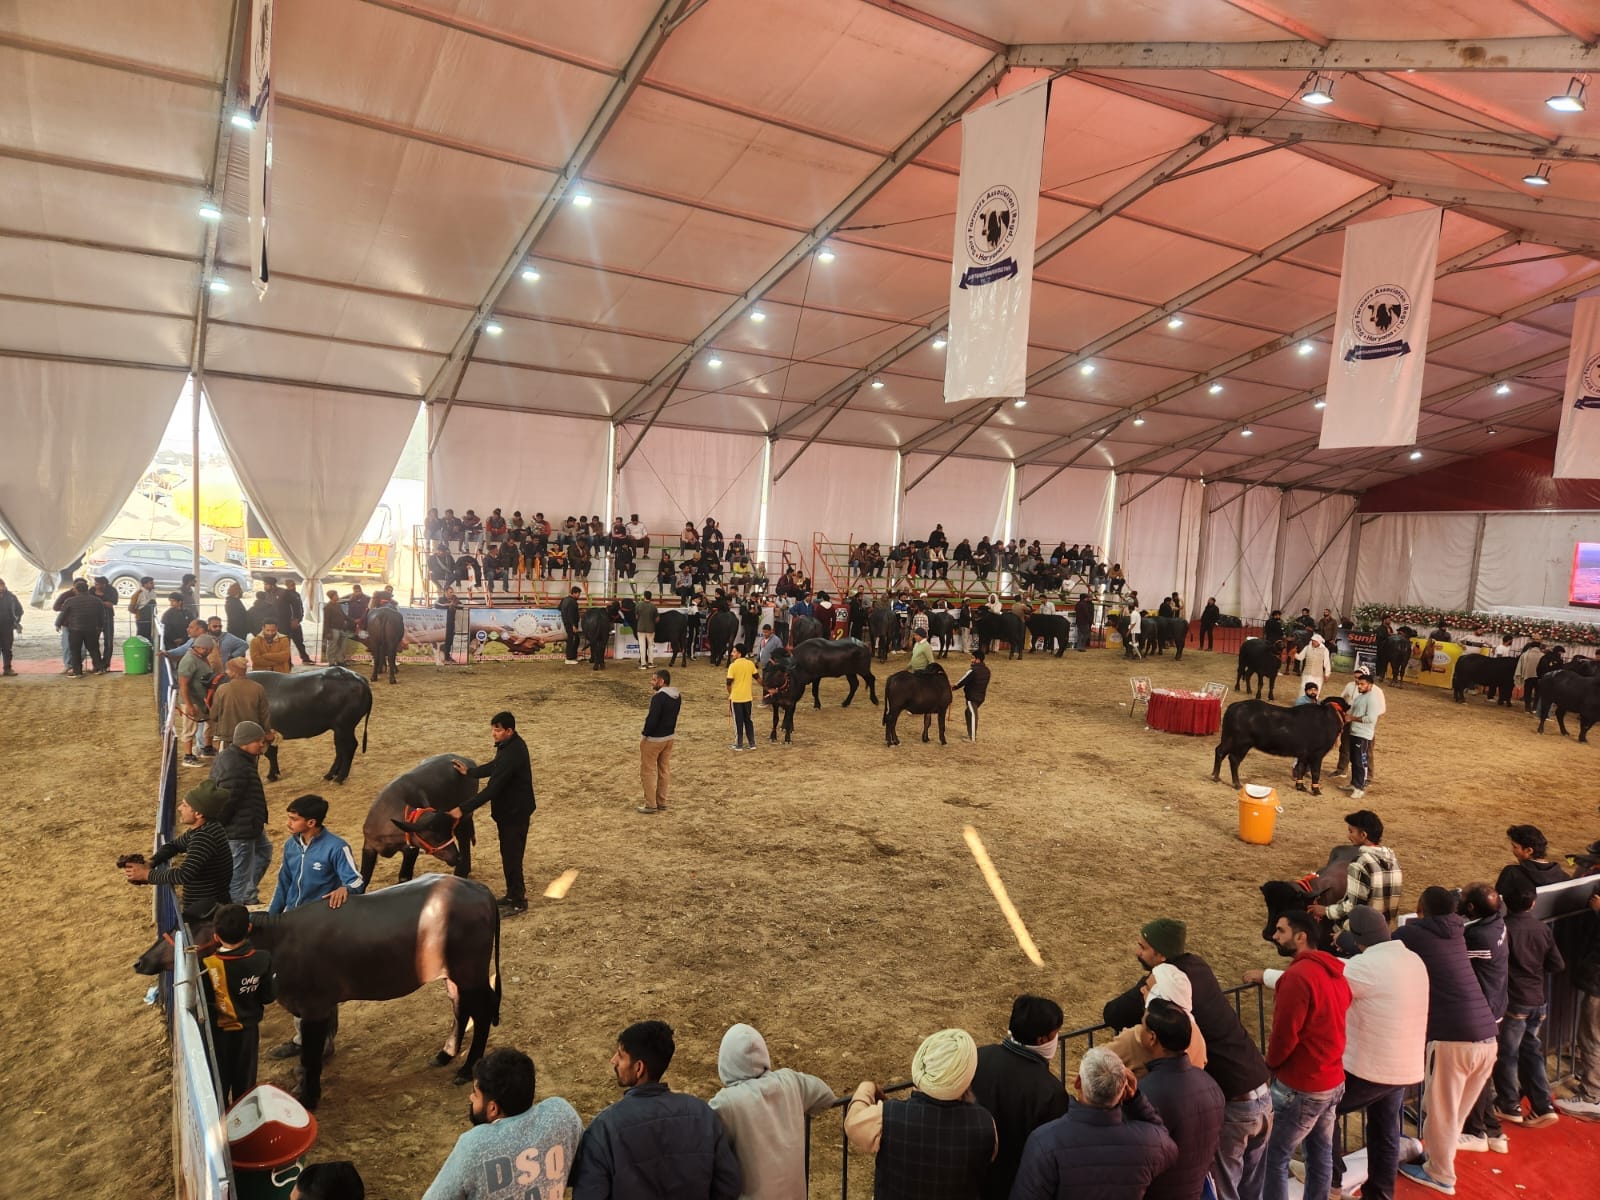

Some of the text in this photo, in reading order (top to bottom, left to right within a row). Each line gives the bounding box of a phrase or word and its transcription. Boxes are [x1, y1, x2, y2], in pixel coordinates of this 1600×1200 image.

[968, 200, 985, 233] Farmers
[986, 189, 1015, 208] Association
[1354, 293, 1374, 319] Farmers
[1374, 287, 1406, 303] Association
[241, 974, 260, 986] ONE
